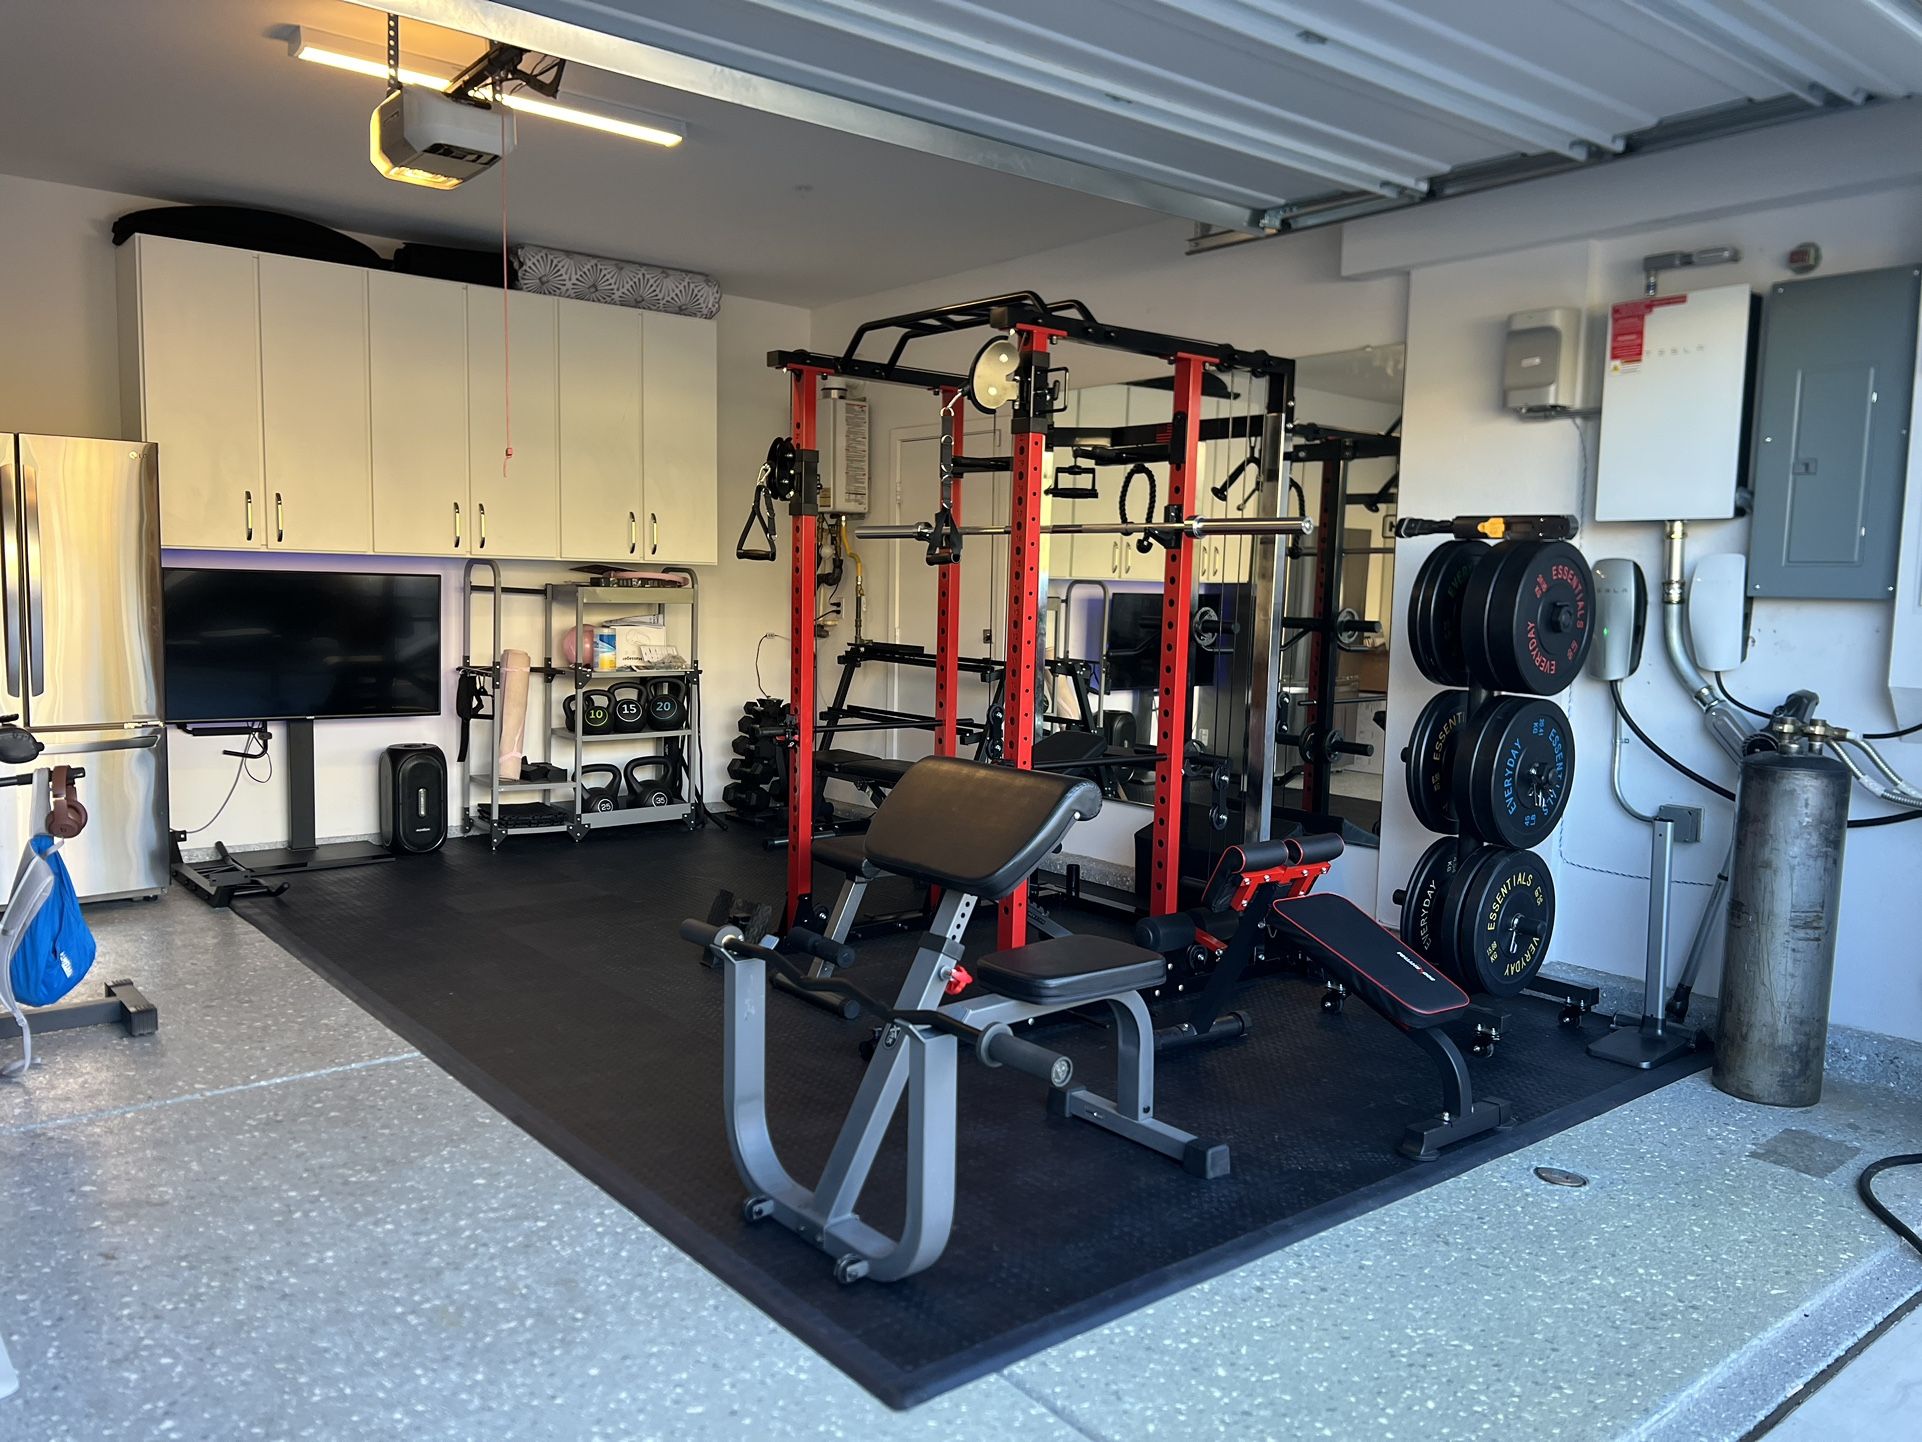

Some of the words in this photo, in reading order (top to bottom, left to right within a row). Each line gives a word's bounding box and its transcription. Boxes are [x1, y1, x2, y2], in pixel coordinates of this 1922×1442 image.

[1551, 565, 1585, 629] ESSENTIALS
[1527, 621, 1556, 674] EVERYDAY
[589, 709, 603, 719] 10
[622, 704, 637, 714] 15
[656, 701, 671, 711] 20
[1433, 711, 1465, 761] ESSENTI
[1503, 738, 1521, 815] EVERYDAY
[600, 803, 611, 811] 25
[1420, 880, 1436, 950] EVERYDAY
[1487, 872, 1533, 931] ESSENTIALS
[1504, 937, 1540, 976] VERYDAY
